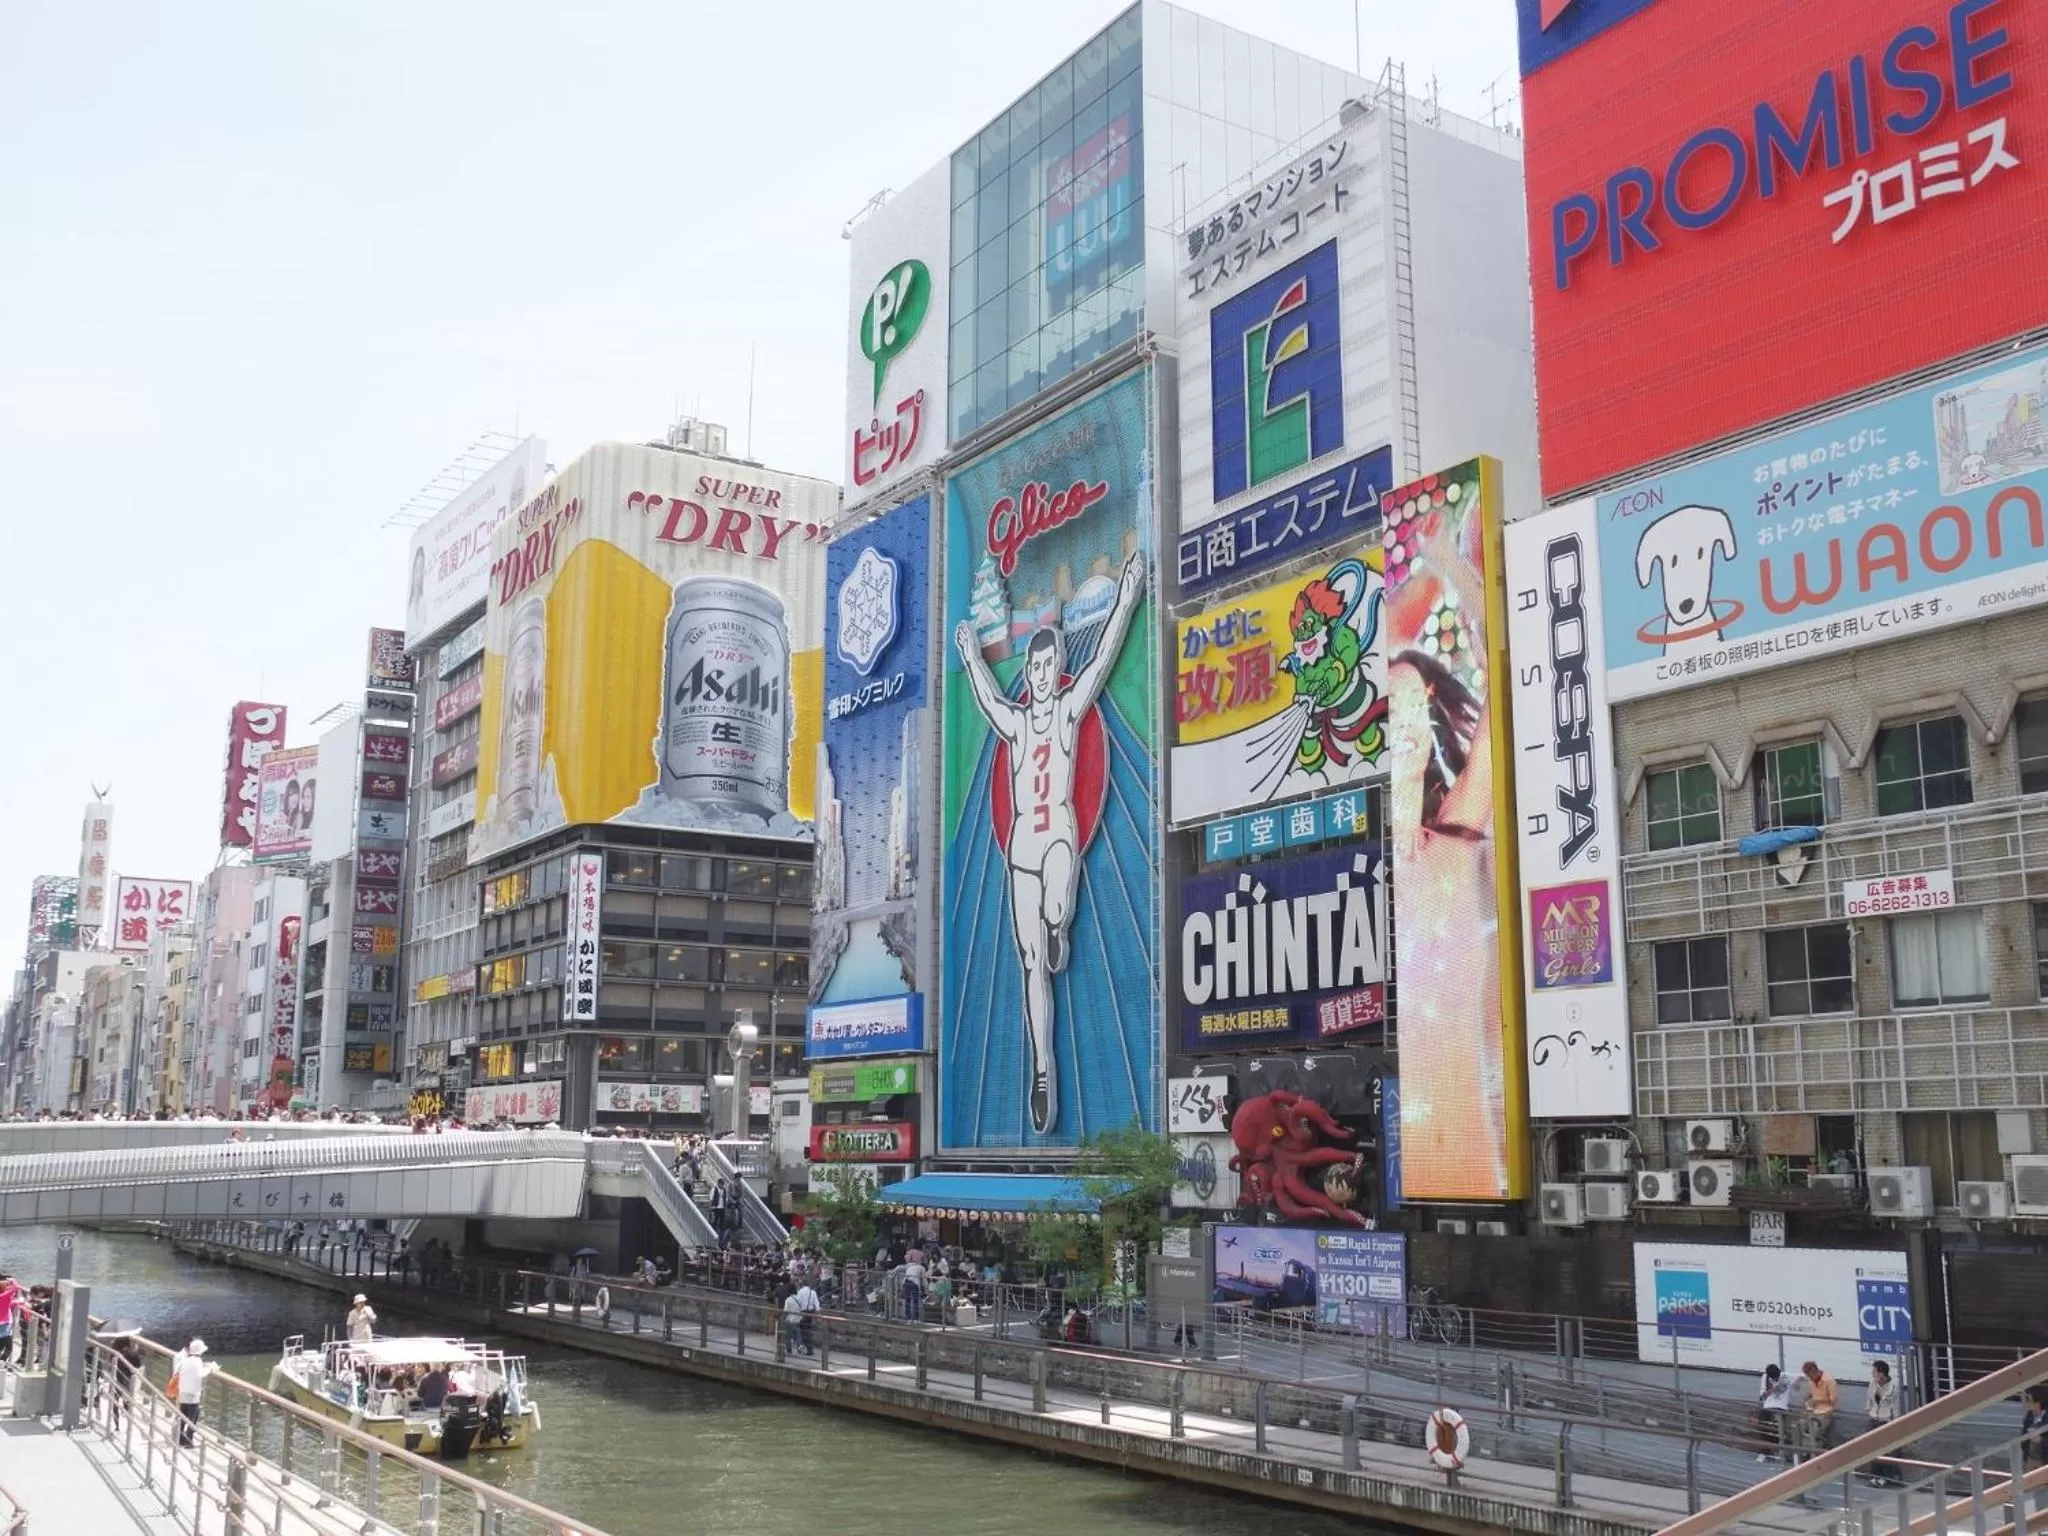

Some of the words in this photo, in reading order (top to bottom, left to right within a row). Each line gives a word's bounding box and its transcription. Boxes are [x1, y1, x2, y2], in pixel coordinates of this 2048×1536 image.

[1552, 0, 2013, 290] PROMISE
[1188, 140, 1347, 260] 夢あるマンション
[1823, 117, 2020, 245] プロミス
[1189, 183, 1348, 299] エステムコート
[853, 388, 924, 487] ピップ
[1753, 426, 1887, 484] お買物のたびに
[517, 484, 559, 535] SUPER
[695, 476, 782, 509] SUPER
[1757, 486, 1919, 547] おトクな電子マネー
[987, 480, 1110, 577] Glico
[1178, 467, 1378, 585] 日商エステム
[1183, 608, 1264, 659] かぜに
[1656, 597, 1953, 681] この看板の照明はLEDを使用しています。
[675, 656, 780, 717] Asahi
[829, 672, 905, 720] 雪印メグミルク
[1175, 641, 1278, 723] 改源
[711, 721, 742, 745] 生
[712, 780, 739, 793] 350ml
[1032, 736, 1053, 834] グリコ
[1212, 796, 1358, 855] 戸堂歯科
[123, 885, 183, 913] かに
[582, 881, 597, 935] 本場の味
[1867, 876, 1928, 898] 広告募集
[577, 939, 596, 1015] かに道楽
[1201, 1007, 1288, 1034] 毎週水曜日発売
[1320, 996, 1354, 1034] 賃貸
[1354, 1001, 1386, 1022] ニュース
[1180, 1084, 1215, 1124] くくる
[232, 1190, 345, 1208] えびす橋
[1751, 1212, 1783, 1229] BAR
[1328, 1253, 1351, 1266] Kansai
[1374, 1256, 1401, 1272] Airport
[1348, 1237, 1370, 1254] Rapid
[1372, 1238, 1401, 1254] Express
[1732, 1298, 1833, 1320] 圧巻の520shops
